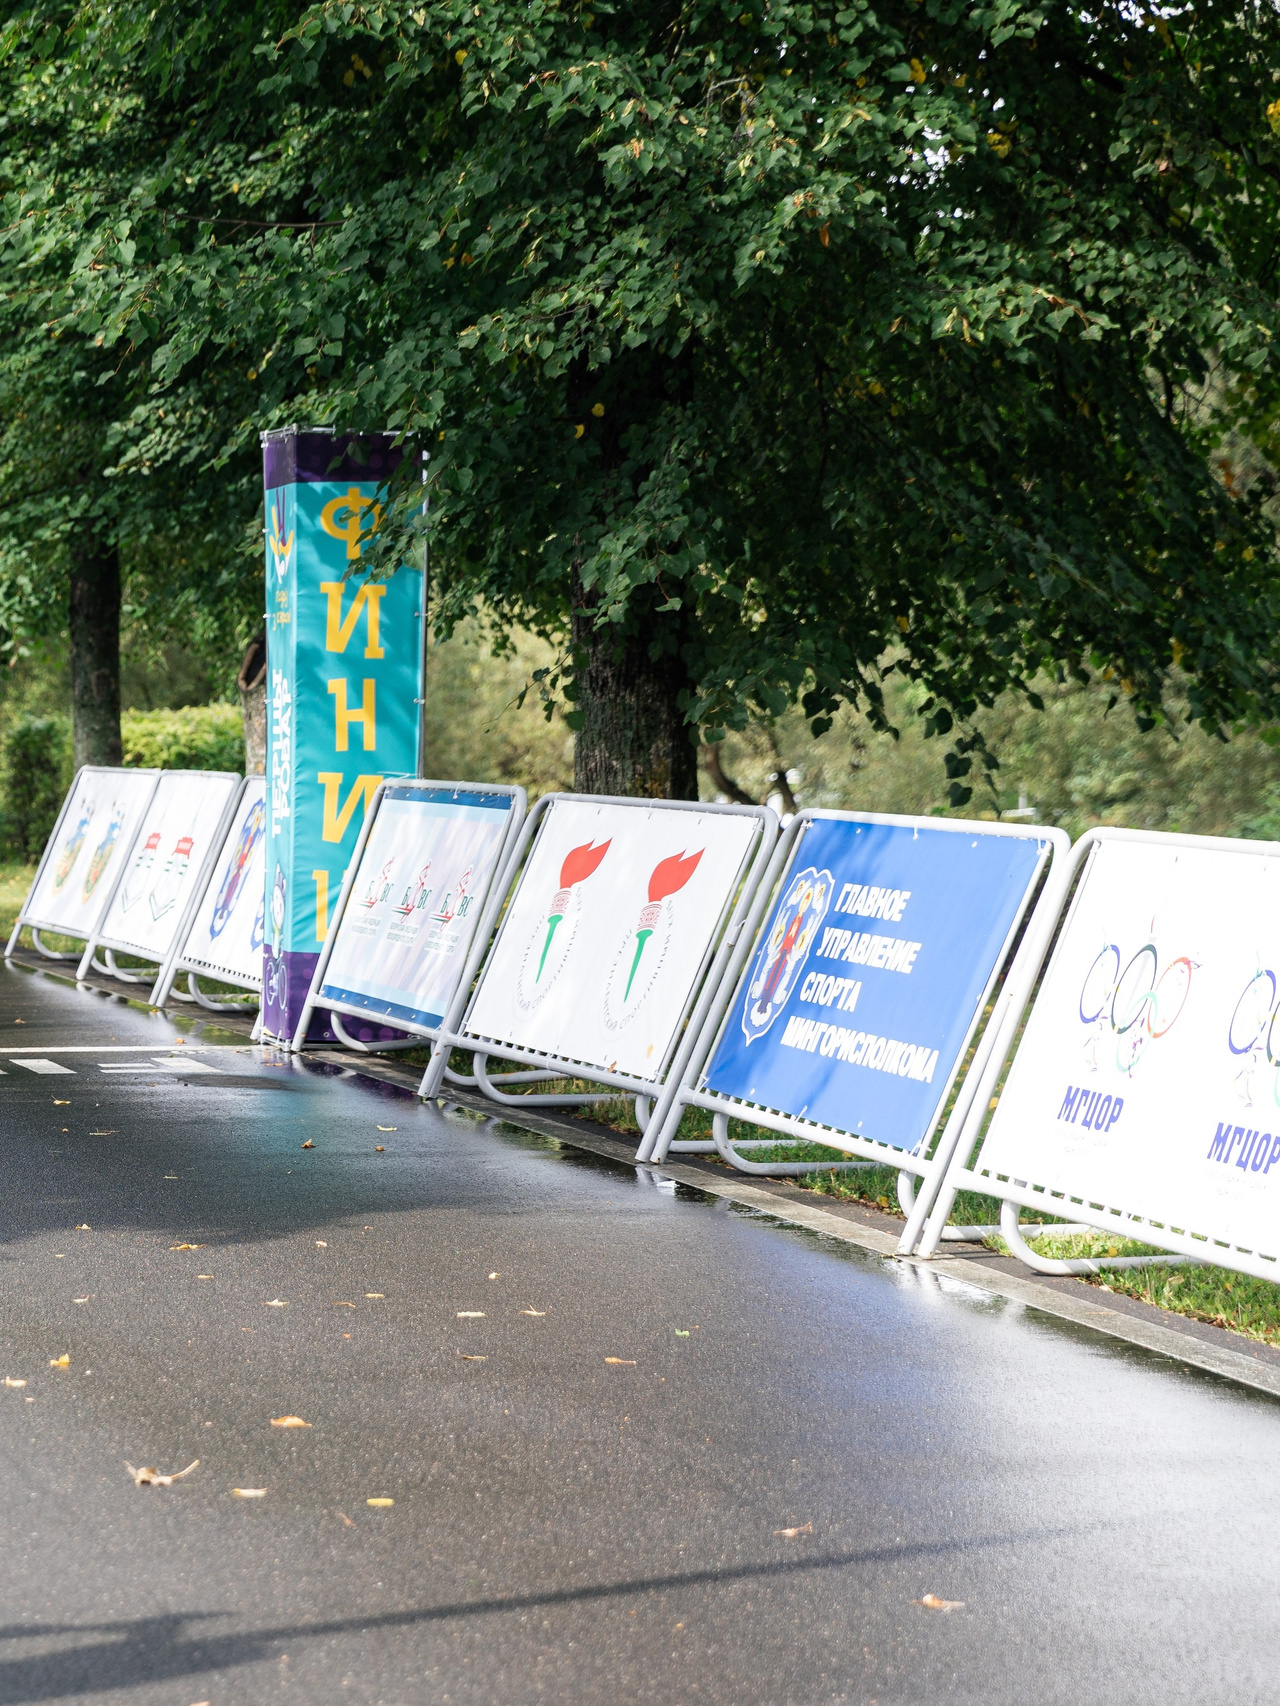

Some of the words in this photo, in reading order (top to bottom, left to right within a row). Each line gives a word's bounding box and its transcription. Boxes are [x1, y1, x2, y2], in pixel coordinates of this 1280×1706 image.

[272, 669, 282, 838] ПЕРШЫ
[280, 678, 292, 819] РОВАР
[834, 883, 912, 922] ГЛАВНОЕ
[816, 926, 922, 974] УПРАВЛЕНИЕ
[800, 971, 862, 1012] СПОРТА
[780, 1015, 939, 1083] МИНГОРИСПОЛКОМА
[1057, 1085, 1124, 1132] МГЦОР
[1207, 1122, 1280, 1174] МГЦОР
